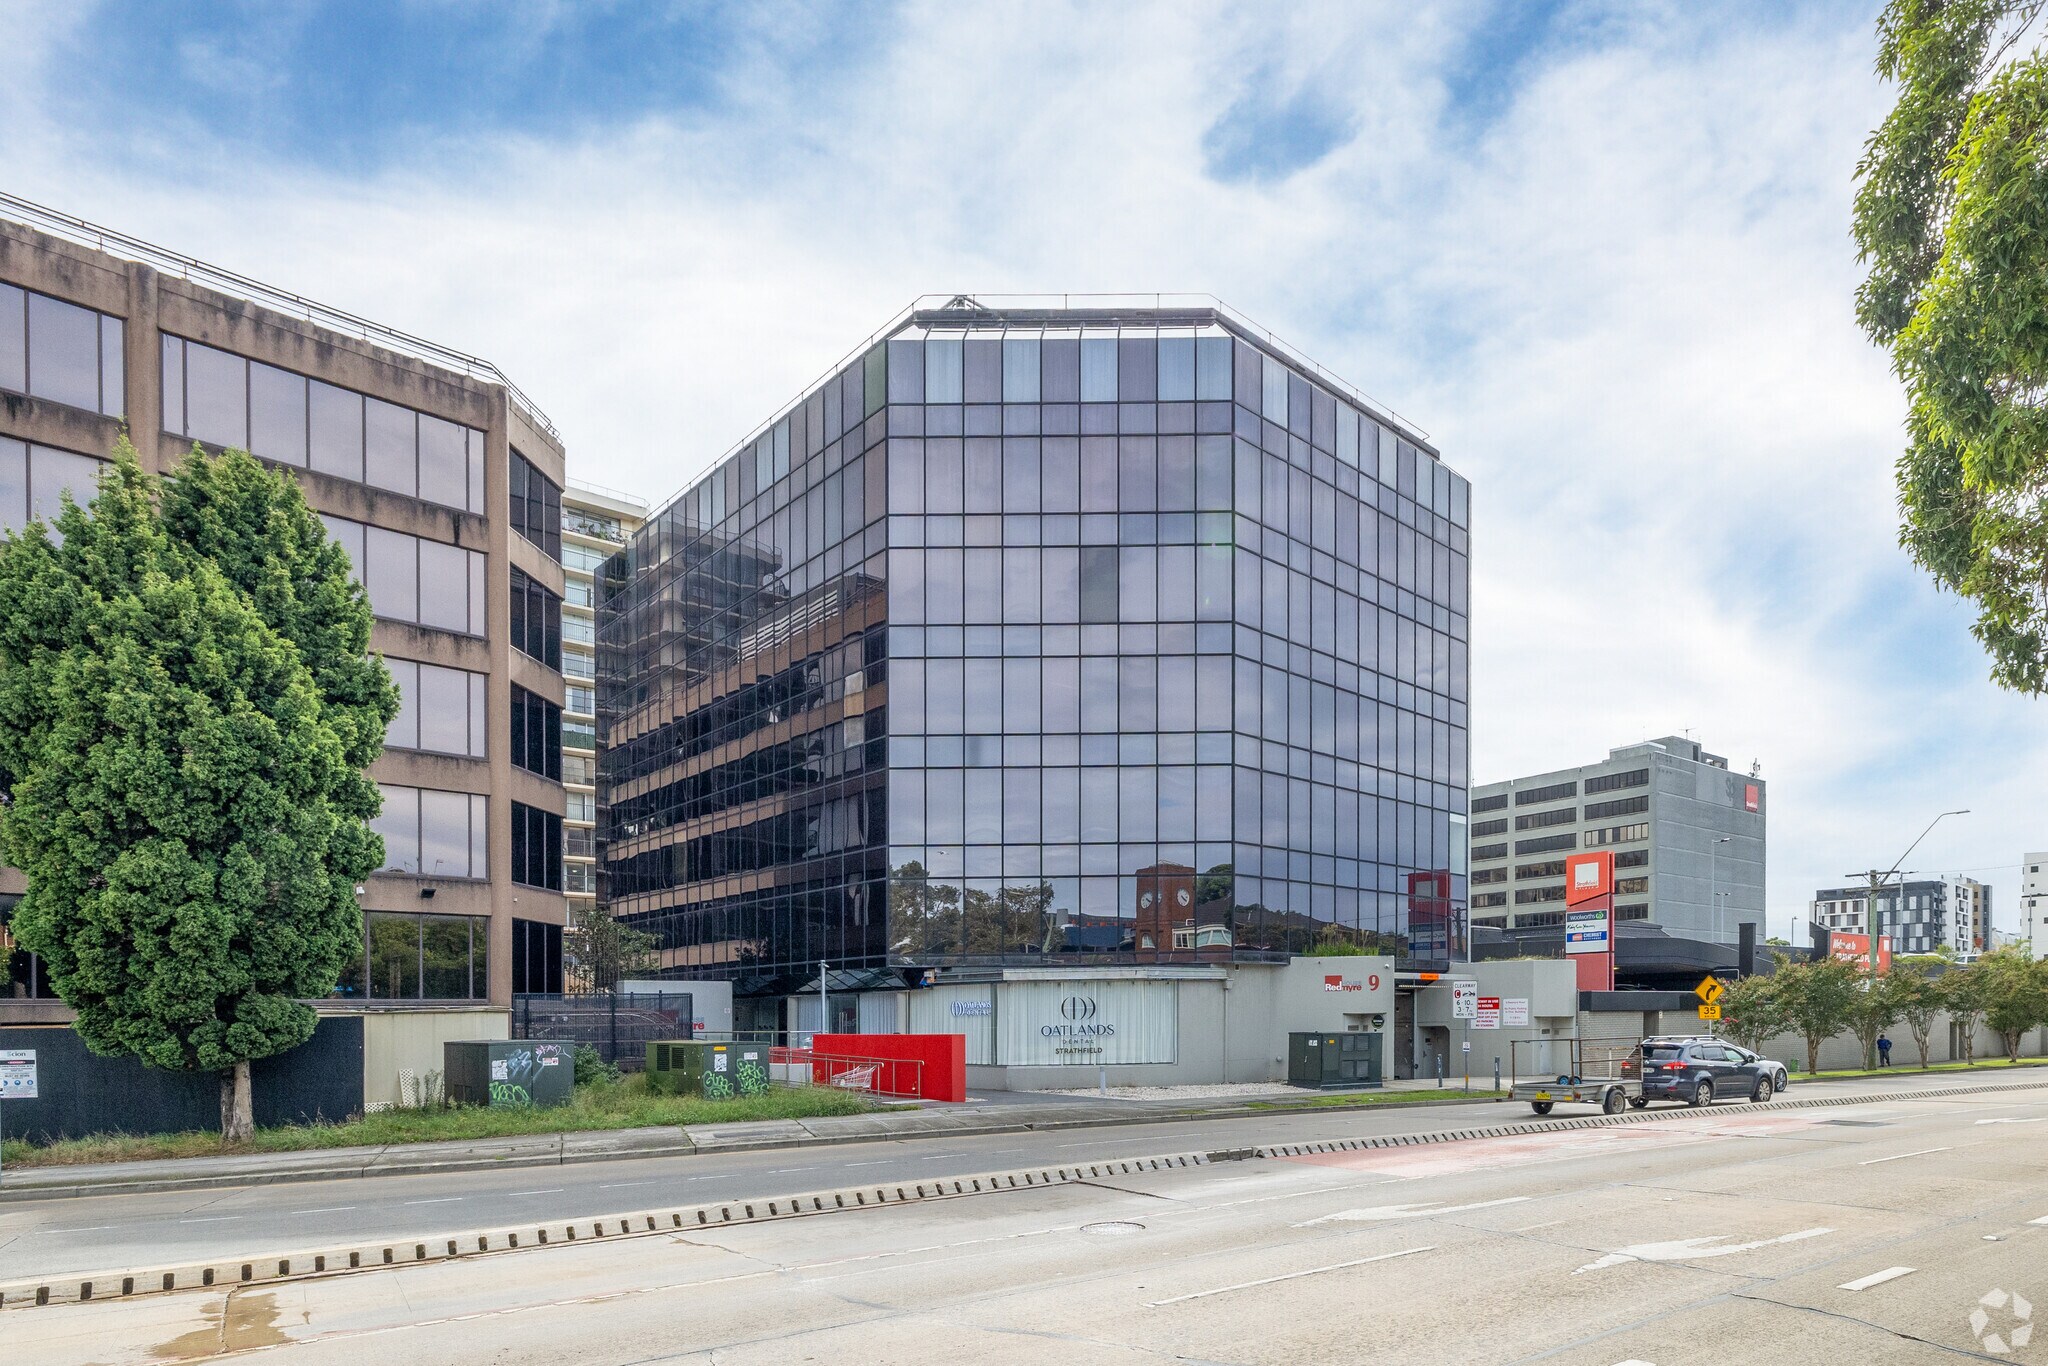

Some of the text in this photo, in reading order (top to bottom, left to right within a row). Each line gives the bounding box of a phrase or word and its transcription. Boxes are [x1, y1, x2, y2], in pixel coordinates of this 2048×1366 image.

[1325, 981, 1362, 992] Redmyre
[1368, 975, 1379, 991] 9
[1704, 1006, 1716, 1015] 35
[1041, 1024, 1115, 1036] OATLANDS
[1055, 1047, 1103, 1055] STRATHFIELD
